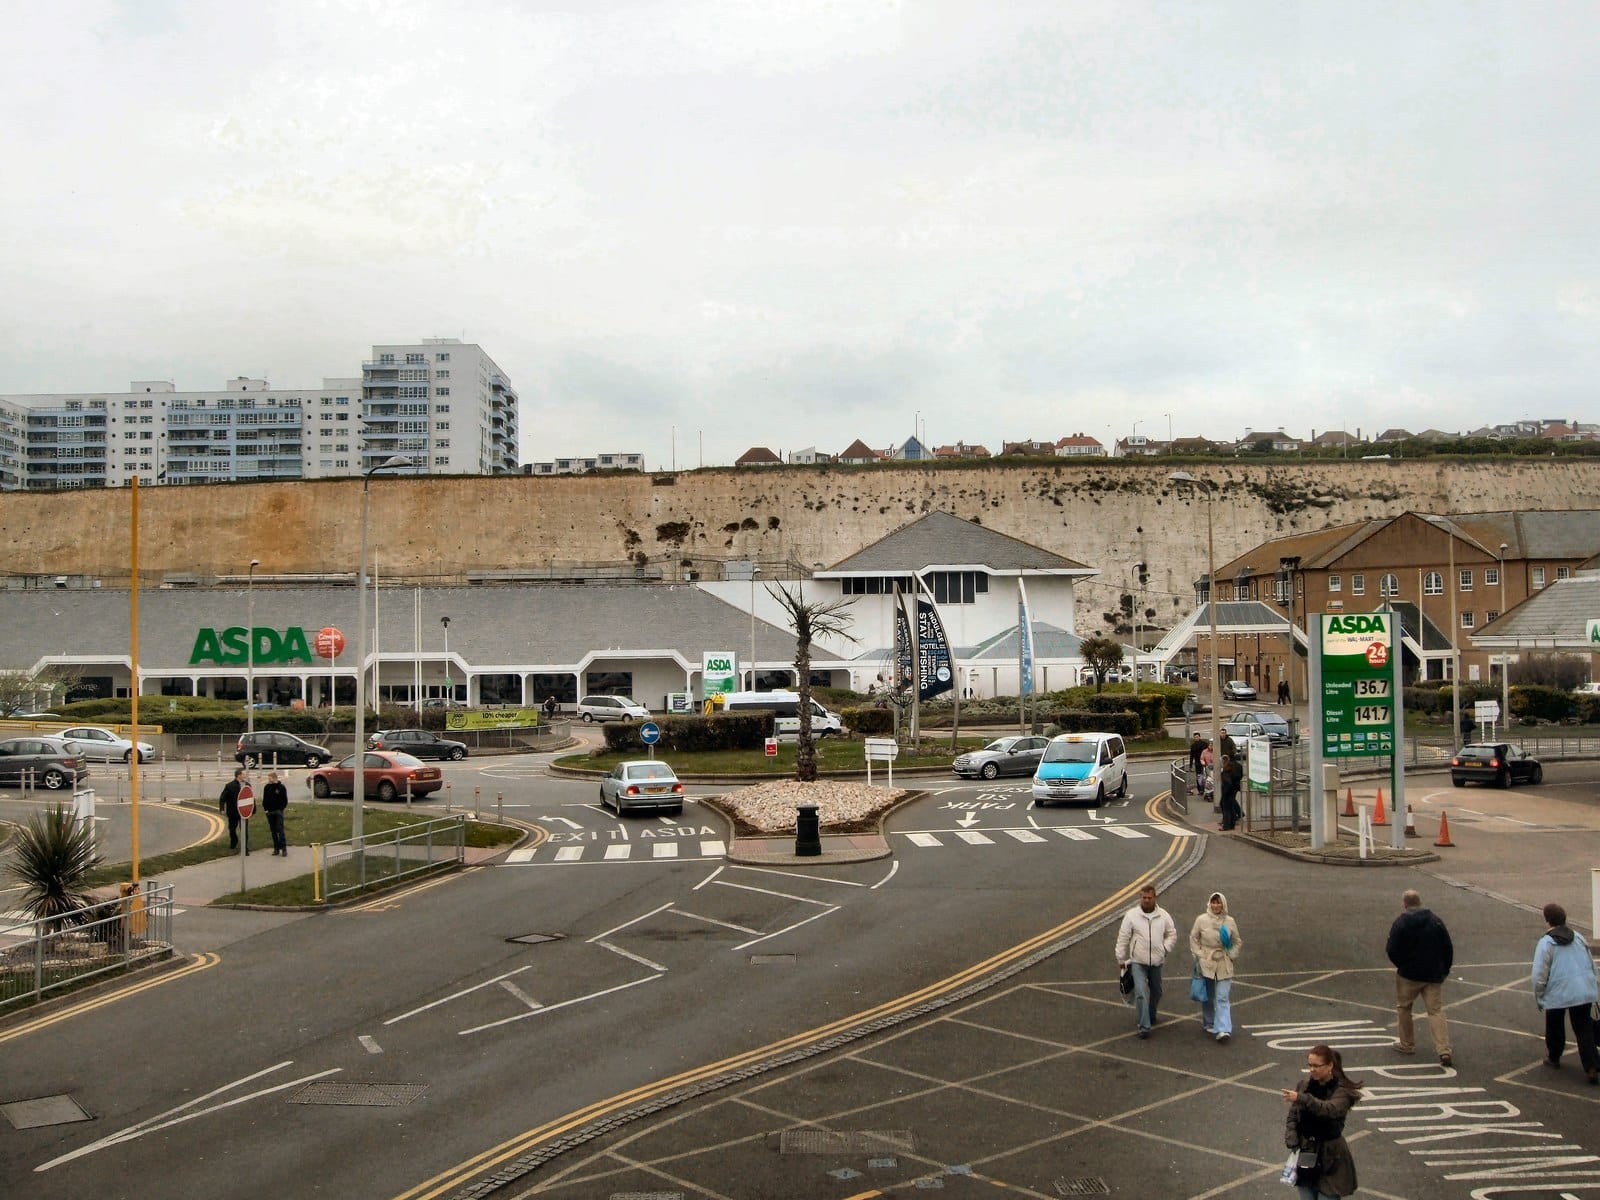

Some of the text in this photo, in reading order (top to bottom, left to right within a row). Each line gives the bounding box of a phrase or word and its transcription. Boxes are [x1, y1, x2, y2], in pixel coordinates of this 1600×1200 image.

[919, 612, 927, 639] STAY
[927, 611, 945, 643] INDULGE
[1327, 615, 1386, 634] ASDA
[188, 626, 313, 665] ASDA
[1368, 645, 1387, 659] 24
[707, 659, 731, 671] ASDA
[919, 650, 928, 690] FISHING
[1354, 680, 1388, 695] 136.7
[495, 711, 517, 719] cheaper
[1355, 706, 1389, 721] 141.7
[547, 825, 716, 843] EXIT ASDA
[1241, 1019, 1400, 1051] NO
